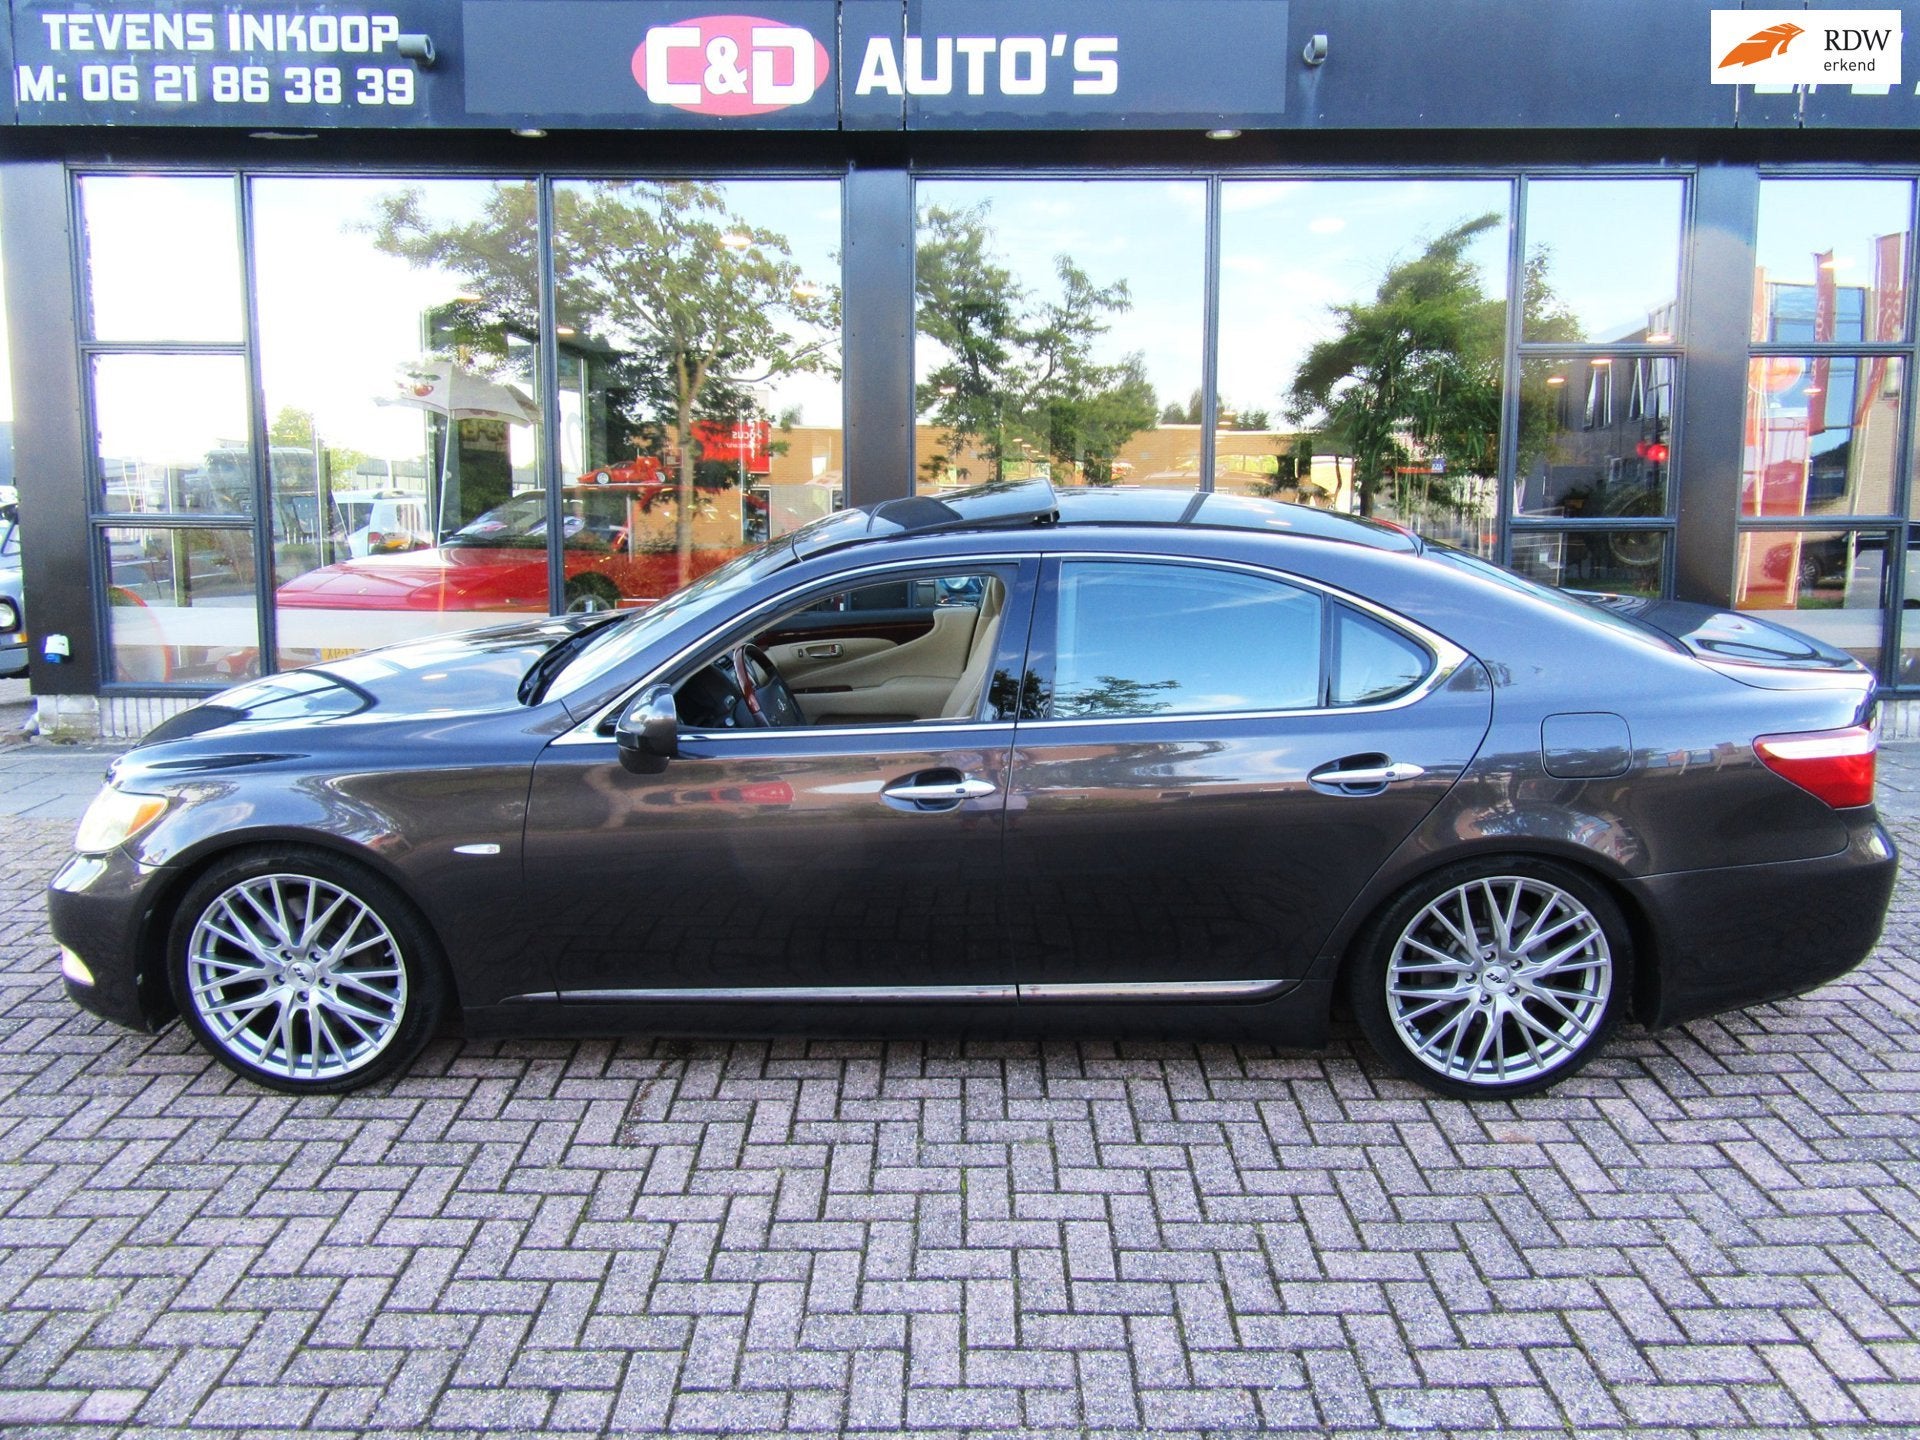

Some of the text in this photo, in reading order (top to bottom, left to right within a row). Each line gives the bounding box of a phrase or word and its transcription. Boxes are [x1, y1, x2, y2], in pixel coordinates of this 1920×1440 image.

[42, 13, 399, 53] TEVENS INKOOP
[18, 65, 415, 105] M: 06 21 86 38 39
[645, 26, 1118, 105] C&D AUTO'S
[1486, 973, 1505, 984] AEZ
